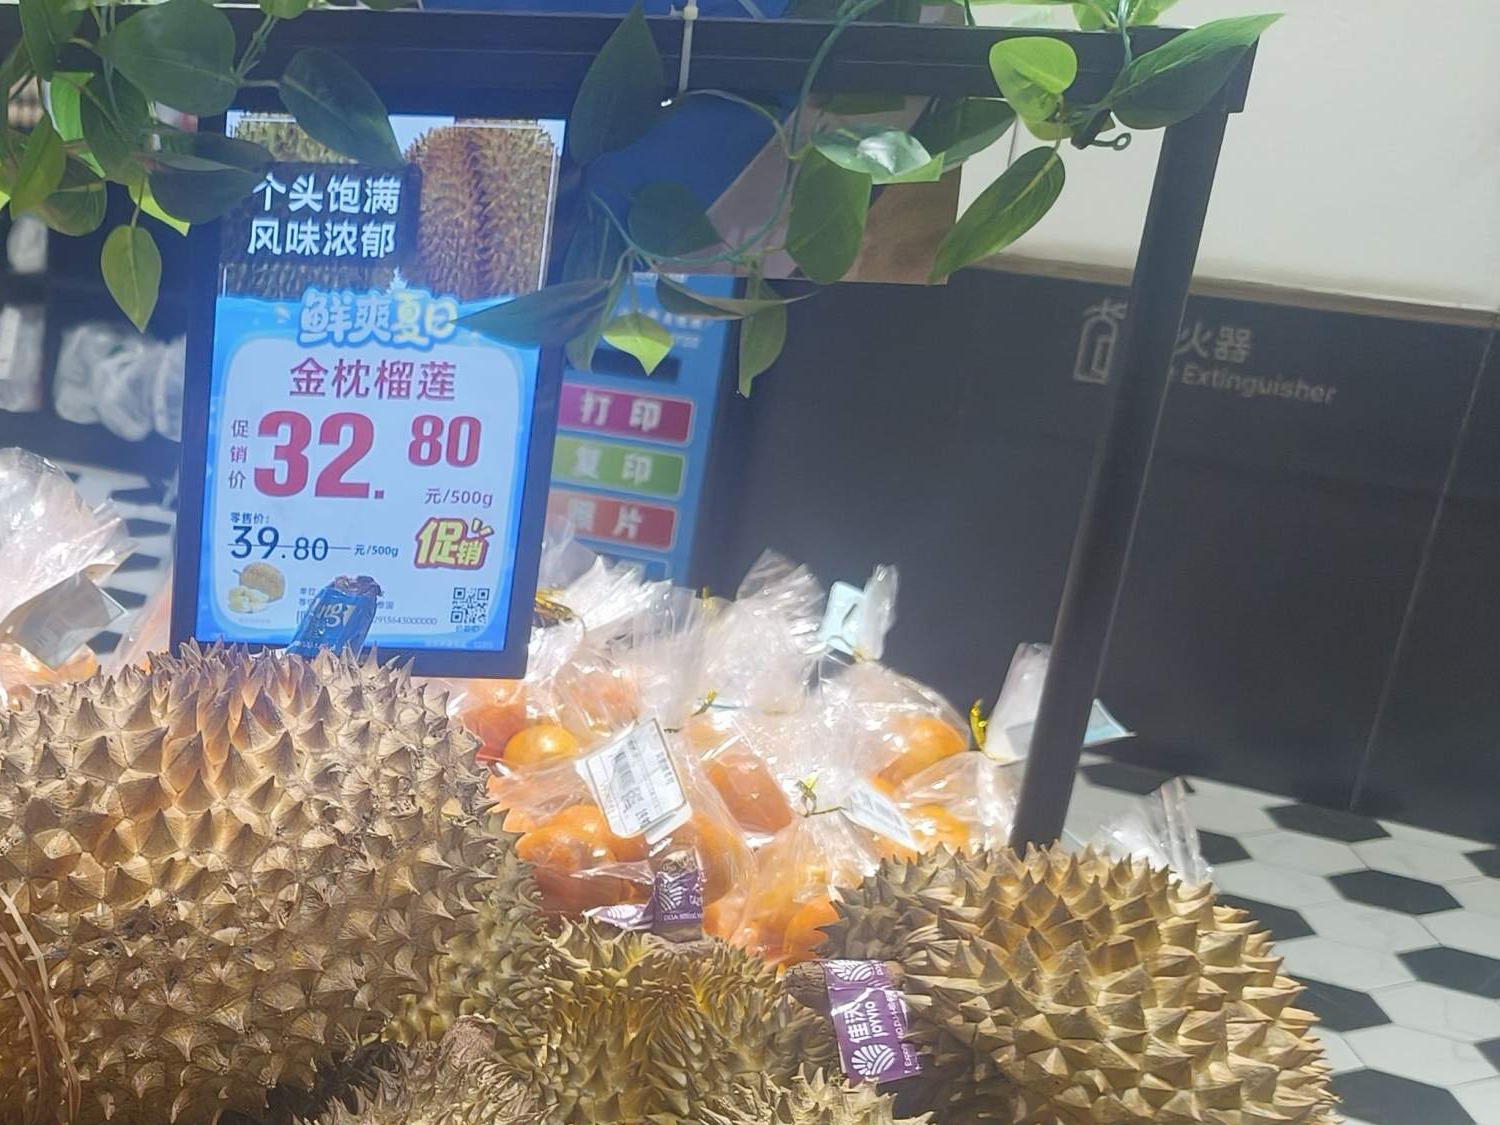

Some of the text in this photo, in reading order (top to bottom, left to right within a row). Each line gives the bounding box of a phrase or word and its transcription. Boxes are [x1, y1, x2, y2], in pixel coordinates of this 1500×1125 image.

[253, 173, 401, 215] 个头饱满
[247, 220, 398, 259] 风味浓郁
[1172, 322, 1251, 364] 火器
[289, 358, 456, 401] 金枕榴莲
[1182, 363, 1337, 404] Extinguisher
[580, 391, 662, 432] 打印
[228, 418, 248, 490] 促销价
[425, 488, 494, 508] 元/500g
[230, 525, 329, 562] 39.80
[354, 544, 399, 557] 元/500g
[415, 517, 489, 570] 促销
[865, 1001, 890, 1038] JOYVIO
